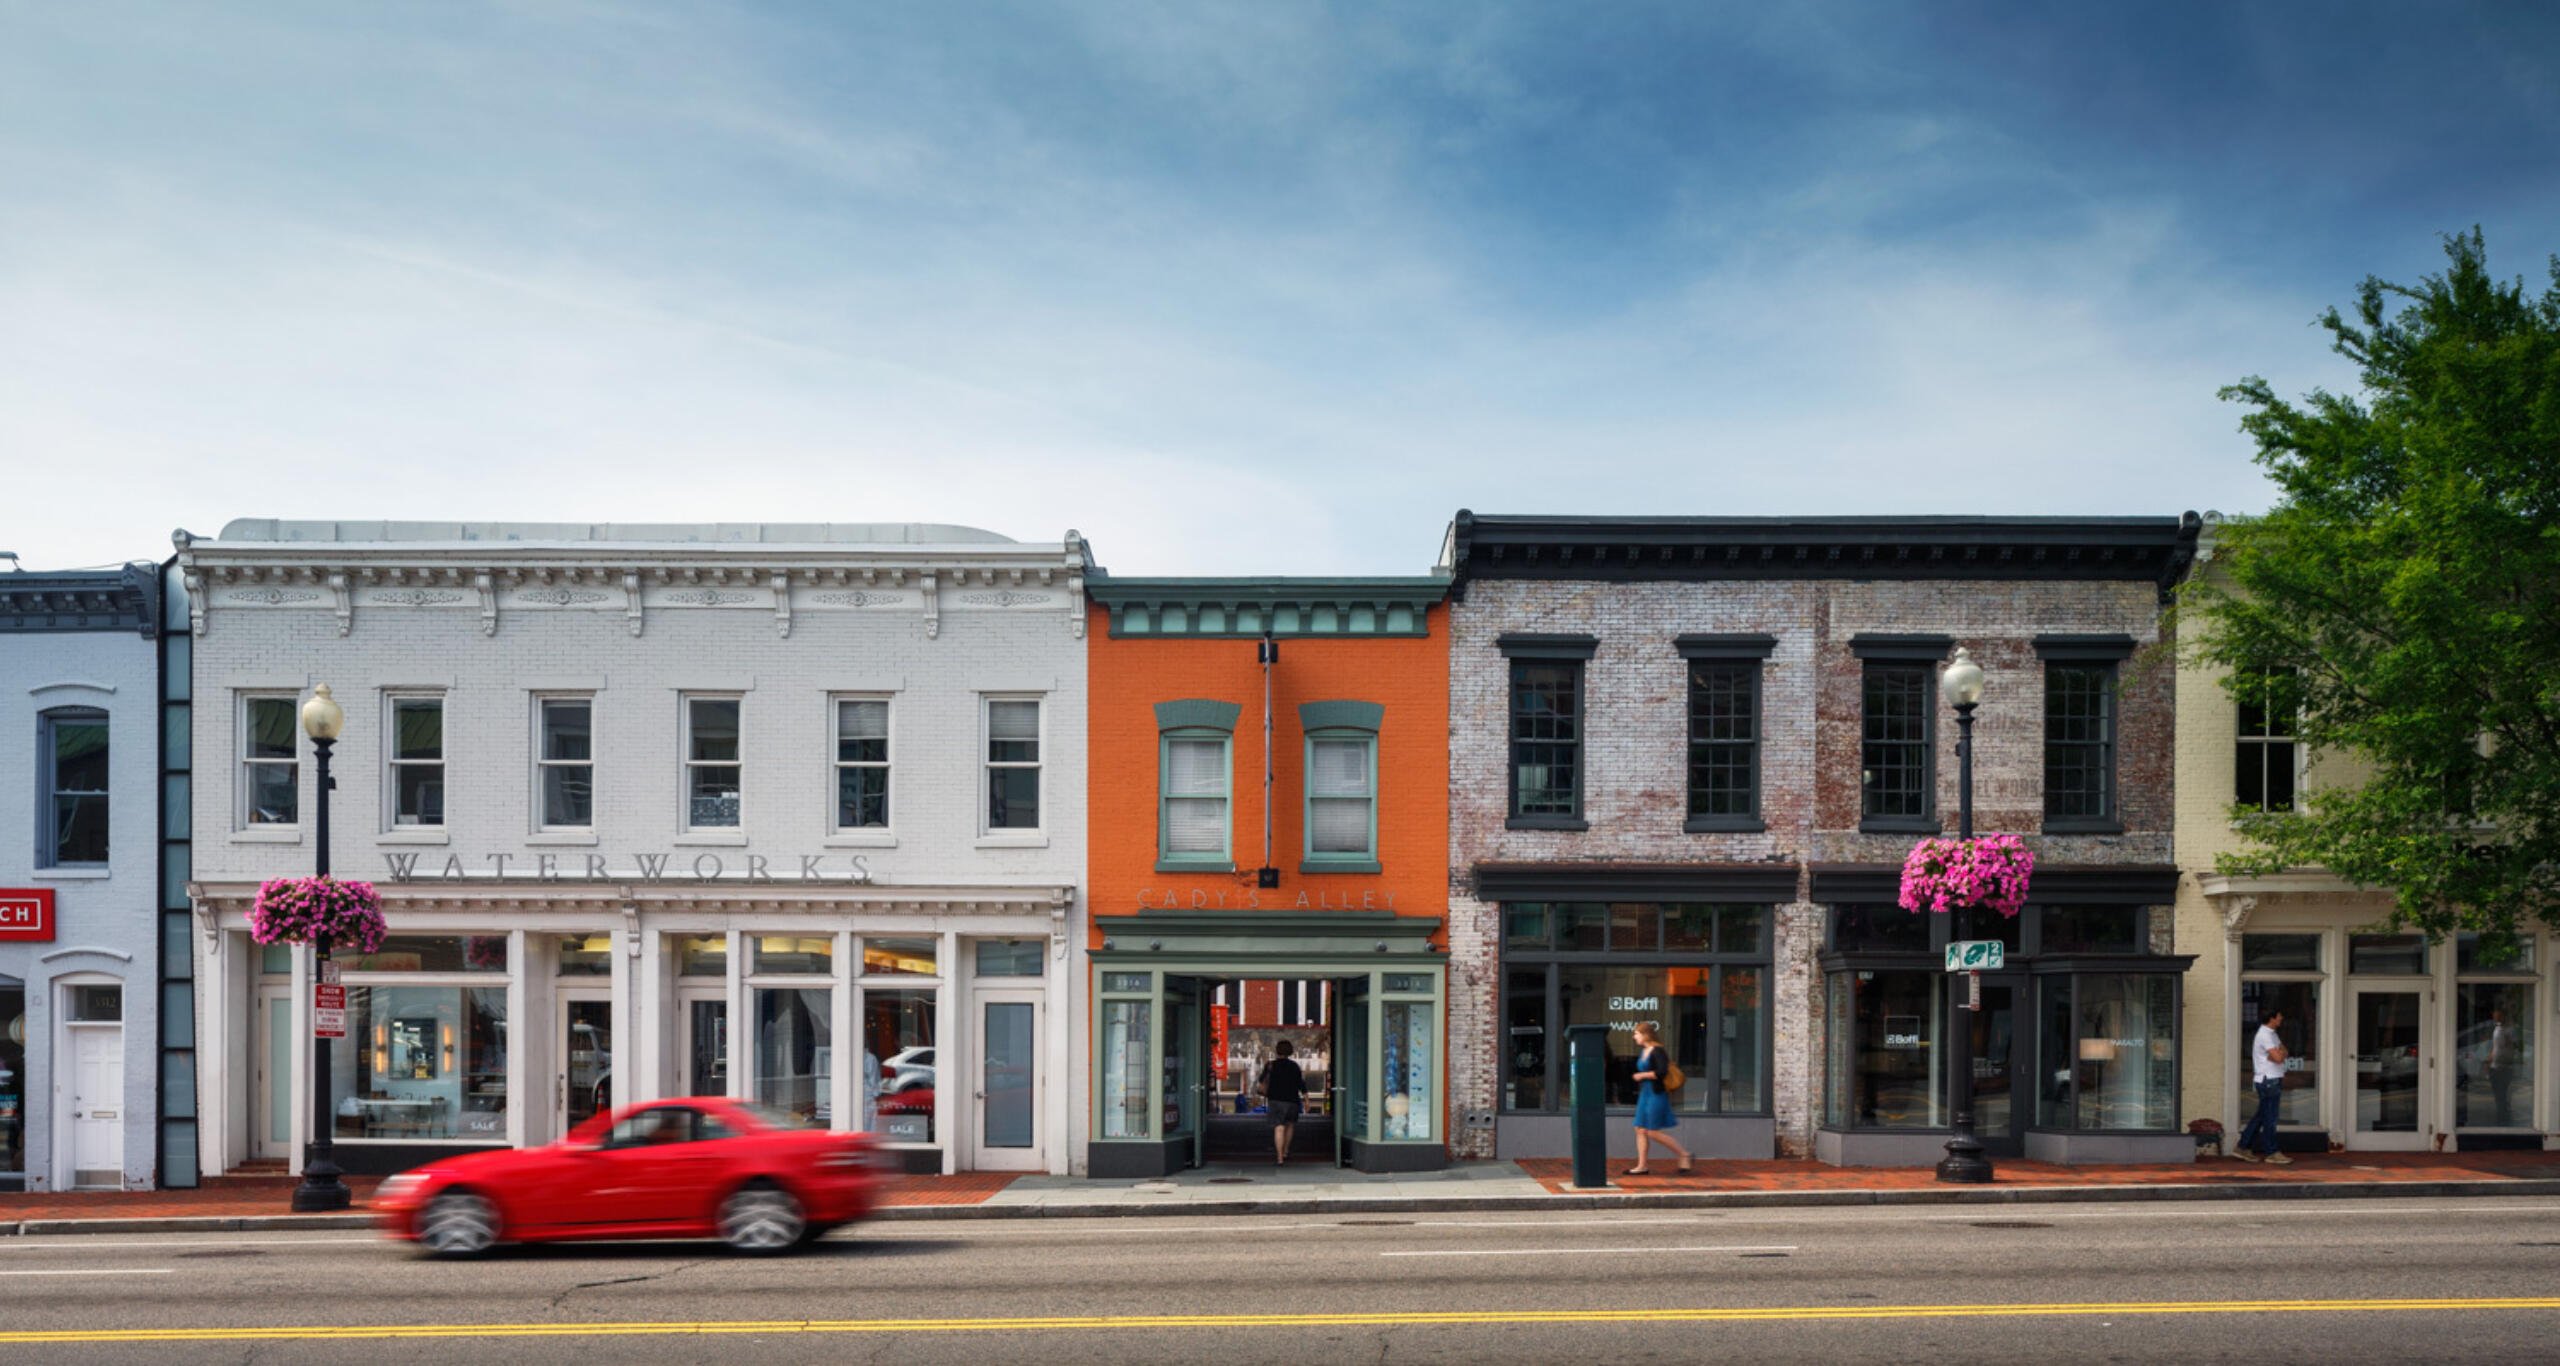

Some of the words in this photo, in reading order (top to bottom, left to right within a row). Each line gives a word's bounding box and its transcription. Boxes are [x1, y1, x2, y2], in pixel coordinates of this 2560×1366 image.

[384, 853, 869, 883] WATERWORKS
[1136, 888, 1260, 908] CADY'S
[1296, 889, 1396, 910] ALLEY
[1623, 997, 1658, 1010] Boffi
[470, 1121, 496, 1130] SALE
[889, 1125, 914, 1134] SALE
